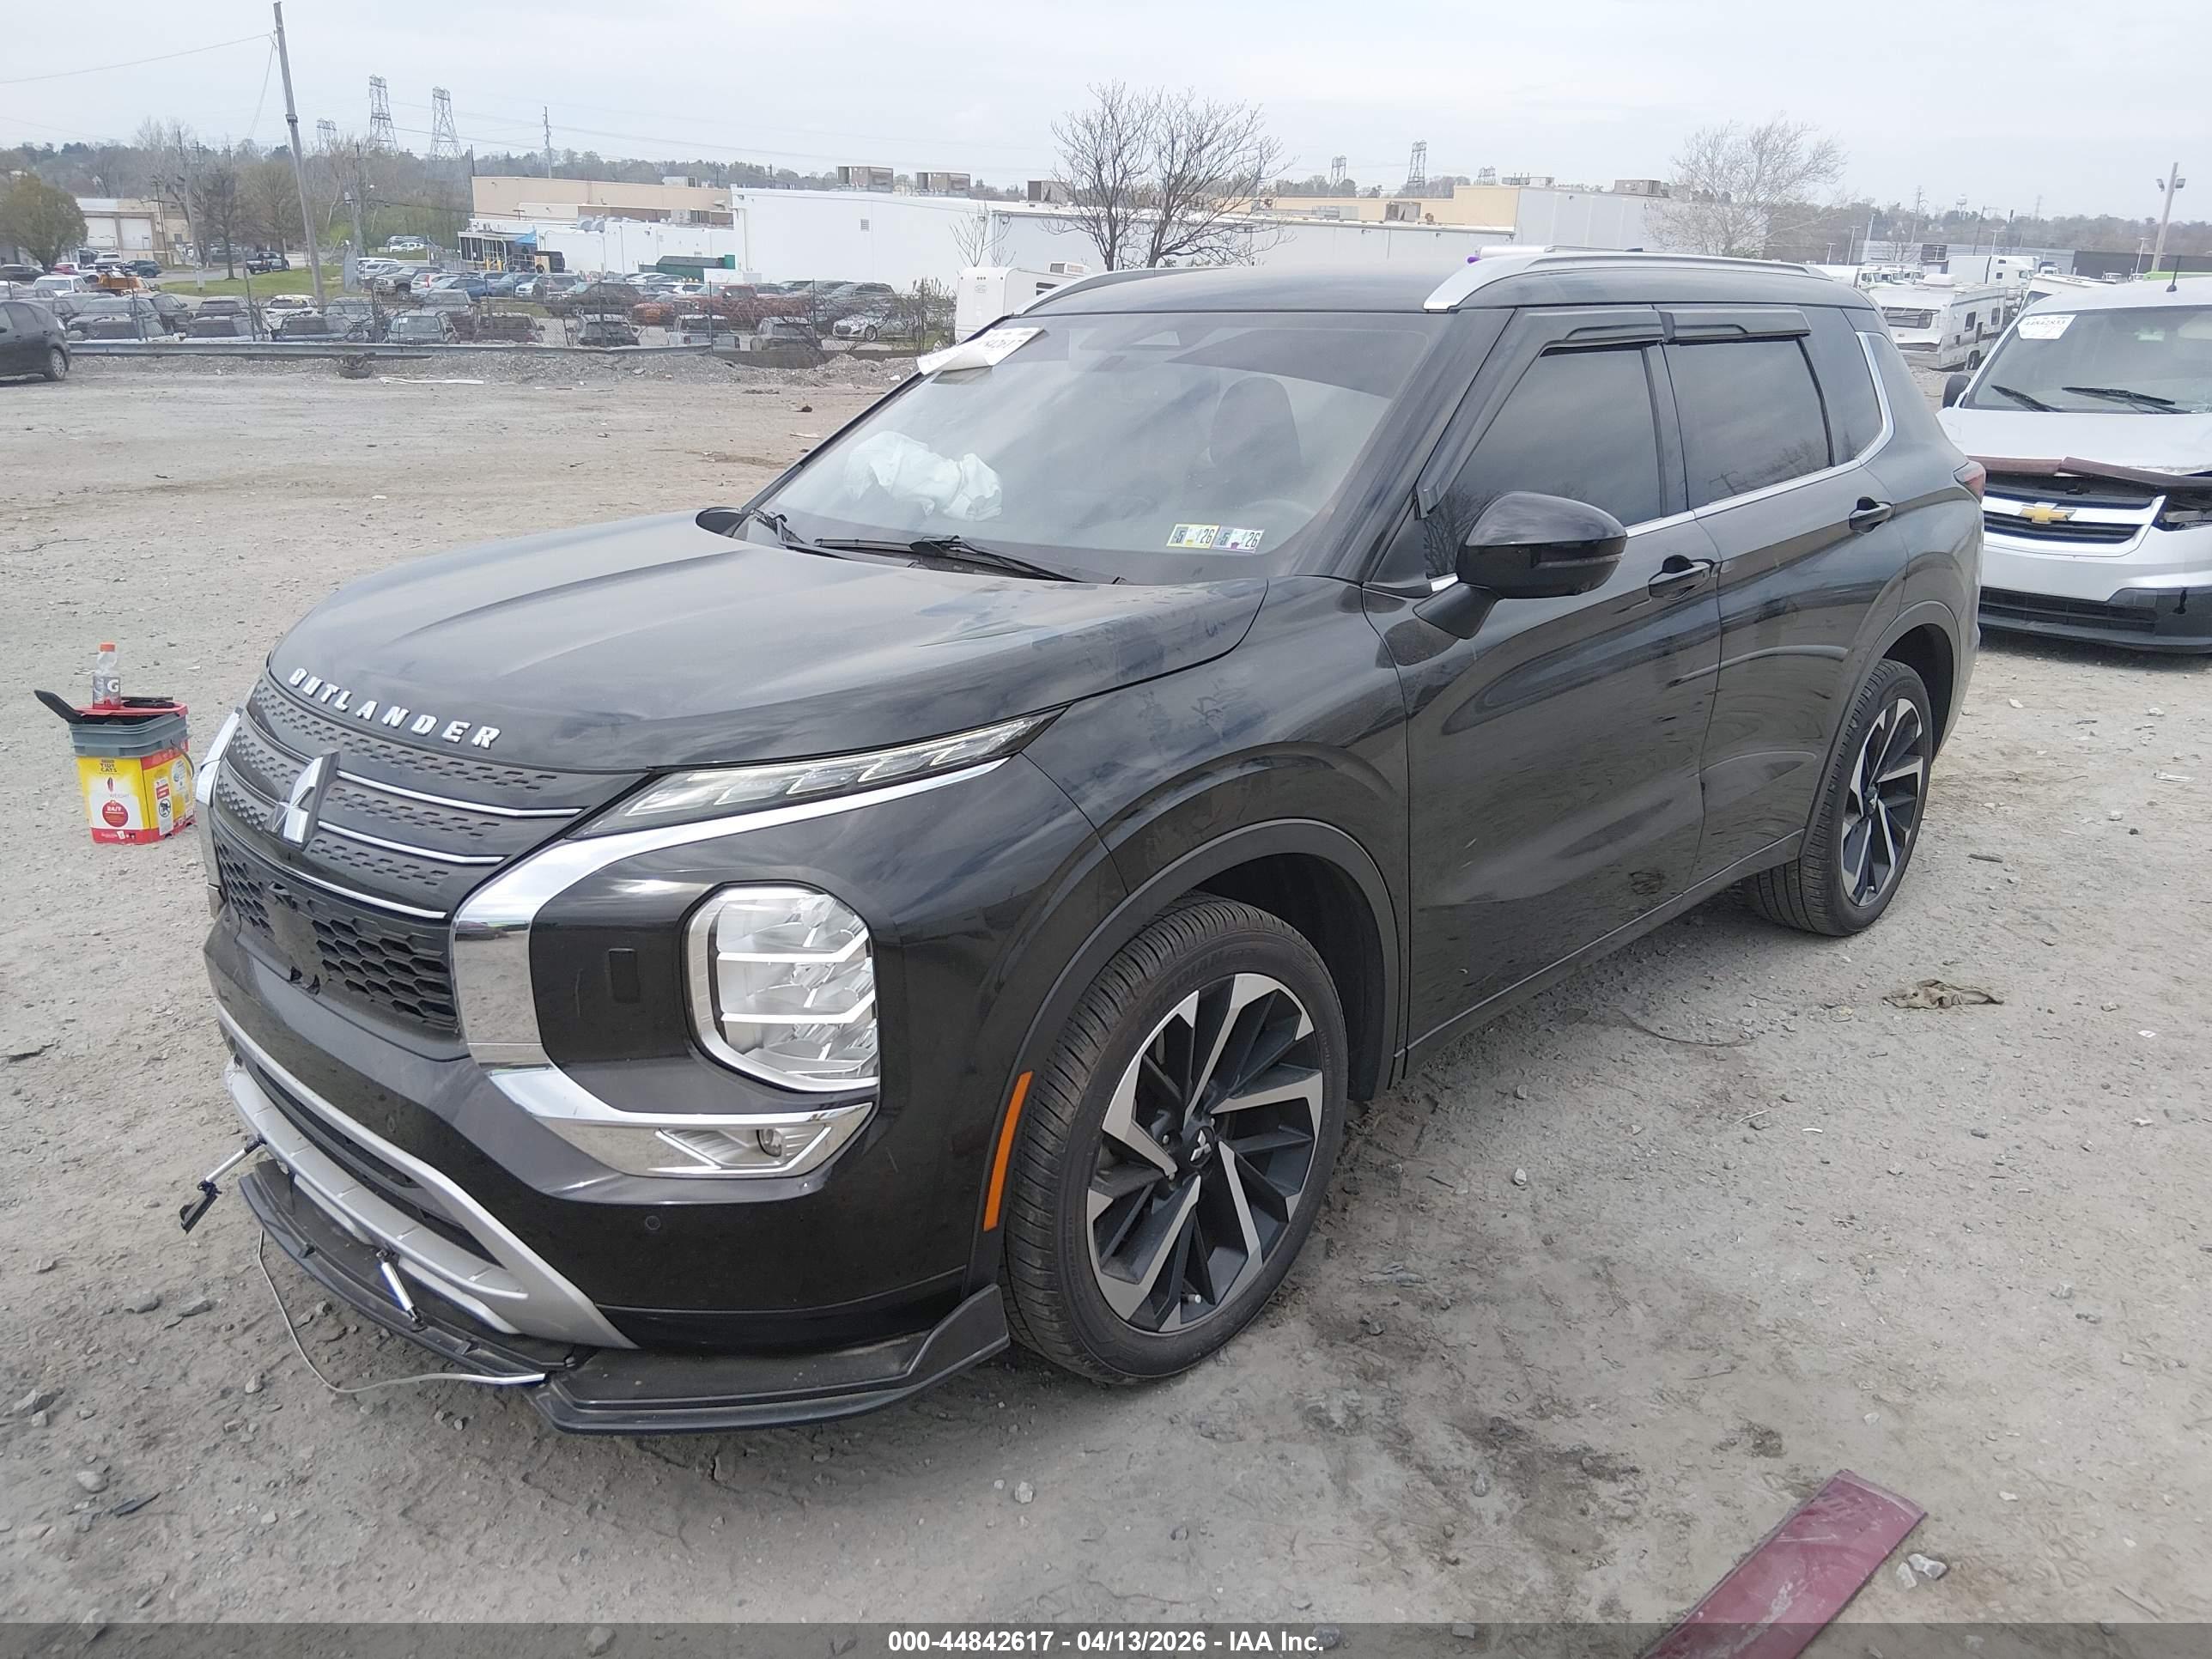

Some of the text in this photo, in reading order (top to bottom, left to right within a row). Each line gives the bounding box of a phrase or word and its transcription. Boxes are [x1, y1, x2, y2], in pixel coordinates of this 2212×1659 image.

[1200, 528, 1215, 544] 26
[1244, 532, 1261, 548] 26
[106, 678, 119, 693] G
[289, 667, 501, 750] OUTLANDER
